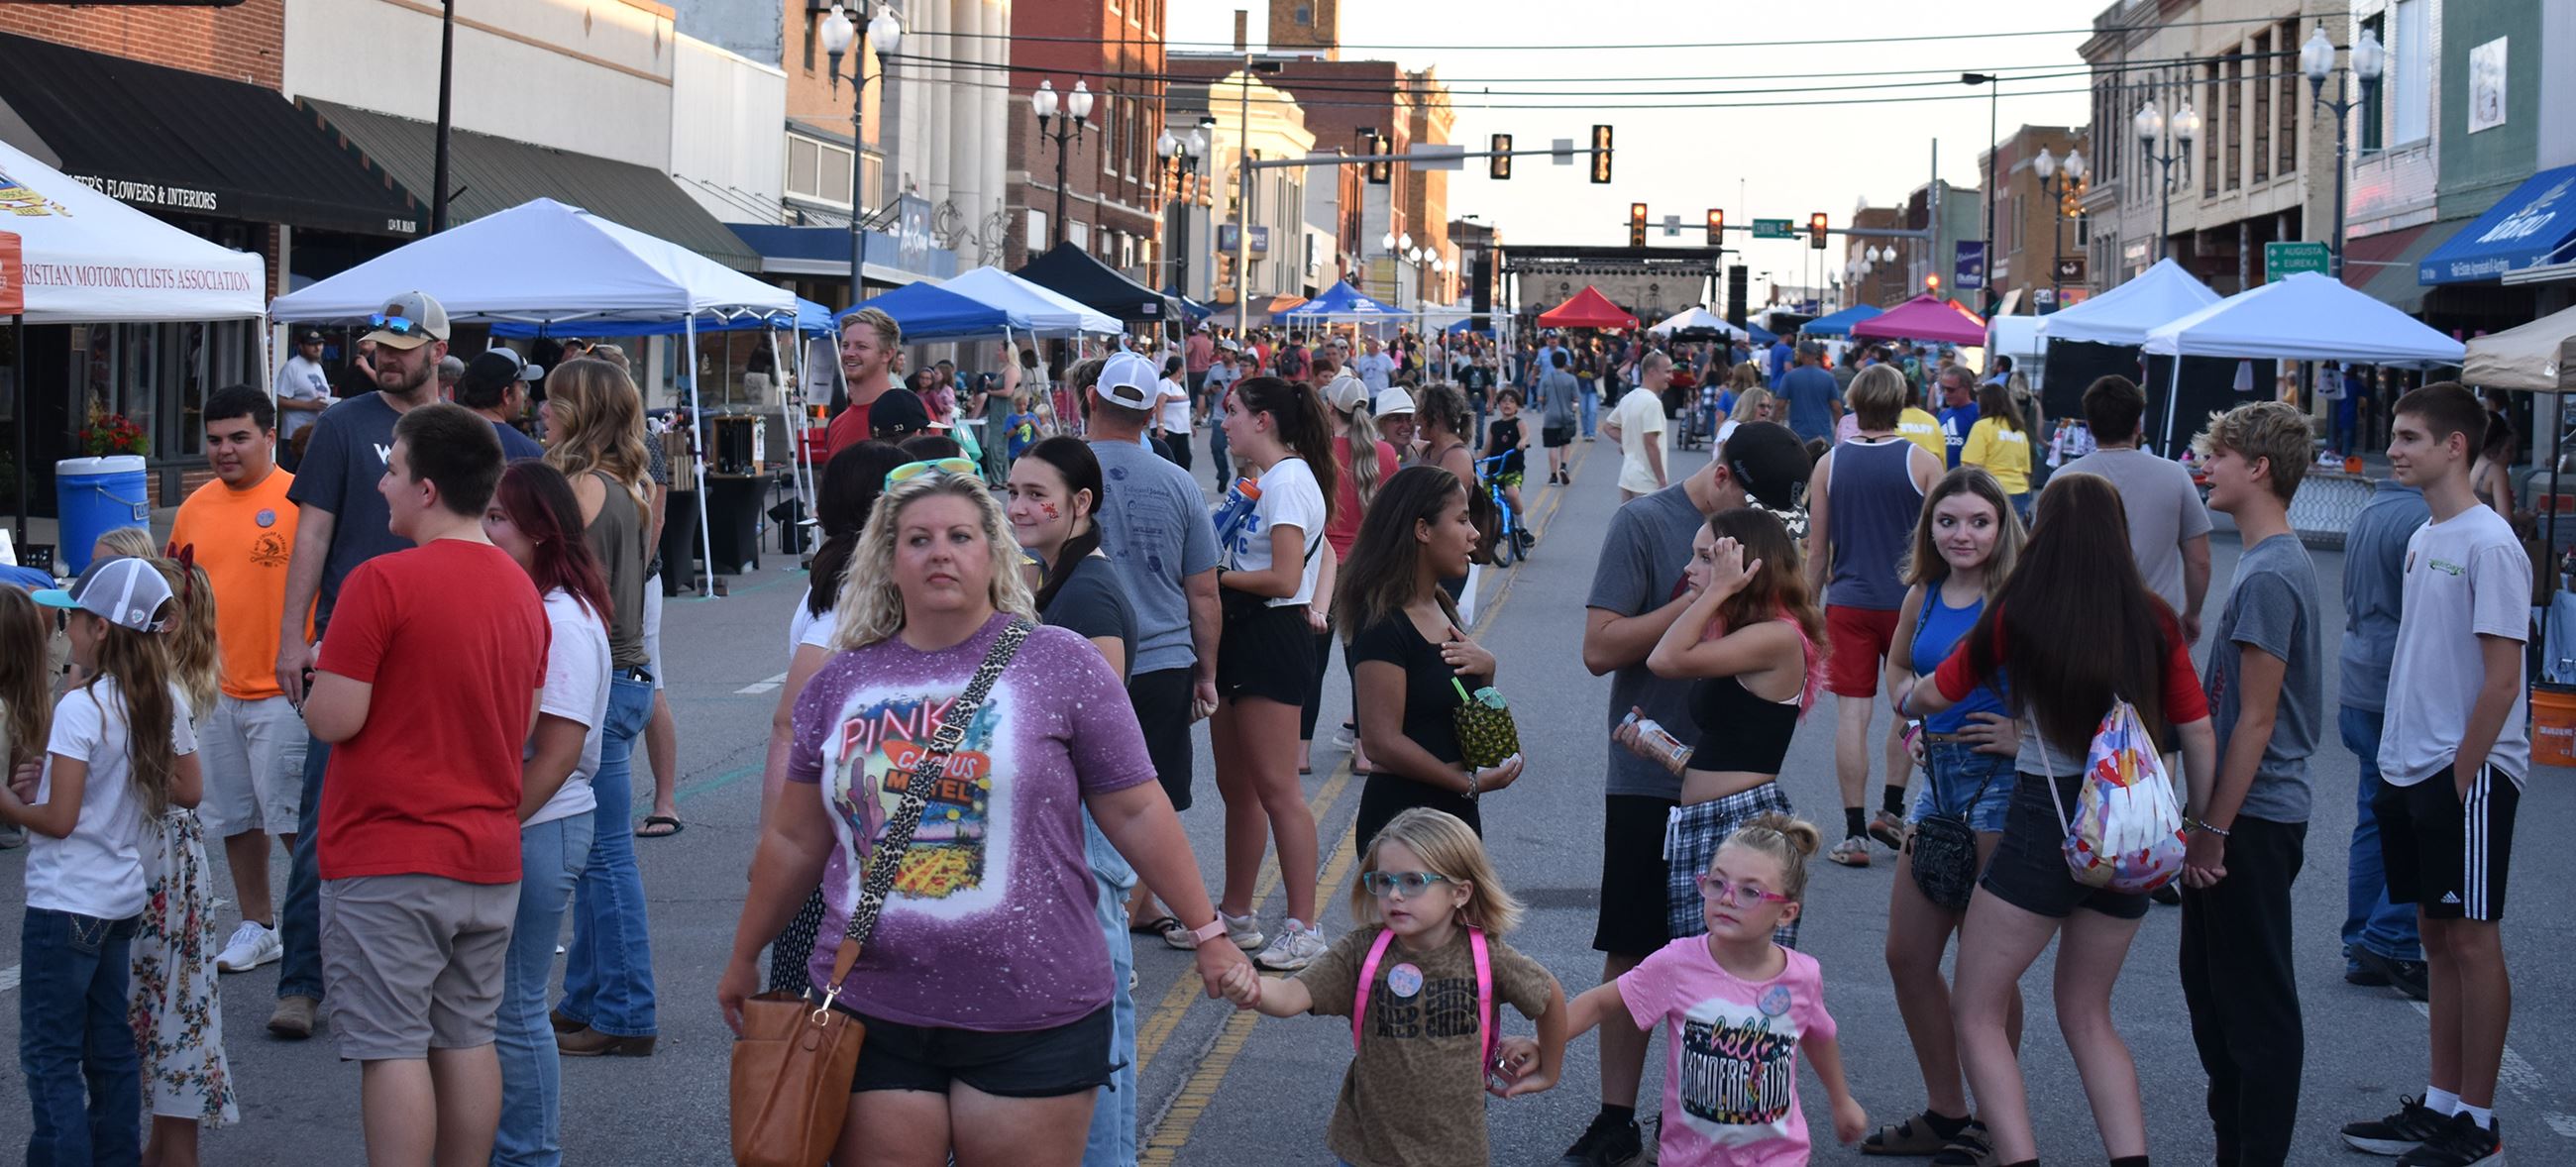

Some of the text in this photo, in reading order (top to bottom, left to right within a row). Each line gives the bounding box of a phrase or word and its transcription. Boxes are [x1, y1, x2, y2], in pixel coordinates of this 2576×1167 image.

[106, 178, 156, 203] FLOWERS
[157, 185, 165, 204] &
[166, 186, 217, 210] INTERIORS
[401, 220, 417, 234] MAIN
[2283, 247, 2323, 257] AUGUSTA
[2283, 259, 2319, 268] EUREKA
[22, 264, 252, 291] RISTIAN MOTORCYCLISTS ASSOCIATION
[894, 423, 905, 432] 33
[840, 697, 955, 760] PINK
[1425, 977, 1478, 999] CHILD
[1425, 991, 1477, 1016] CHILD
[1425, 1008, 1478, 1039] CHILD
[1710, 1014, 1774, 1063] hello
